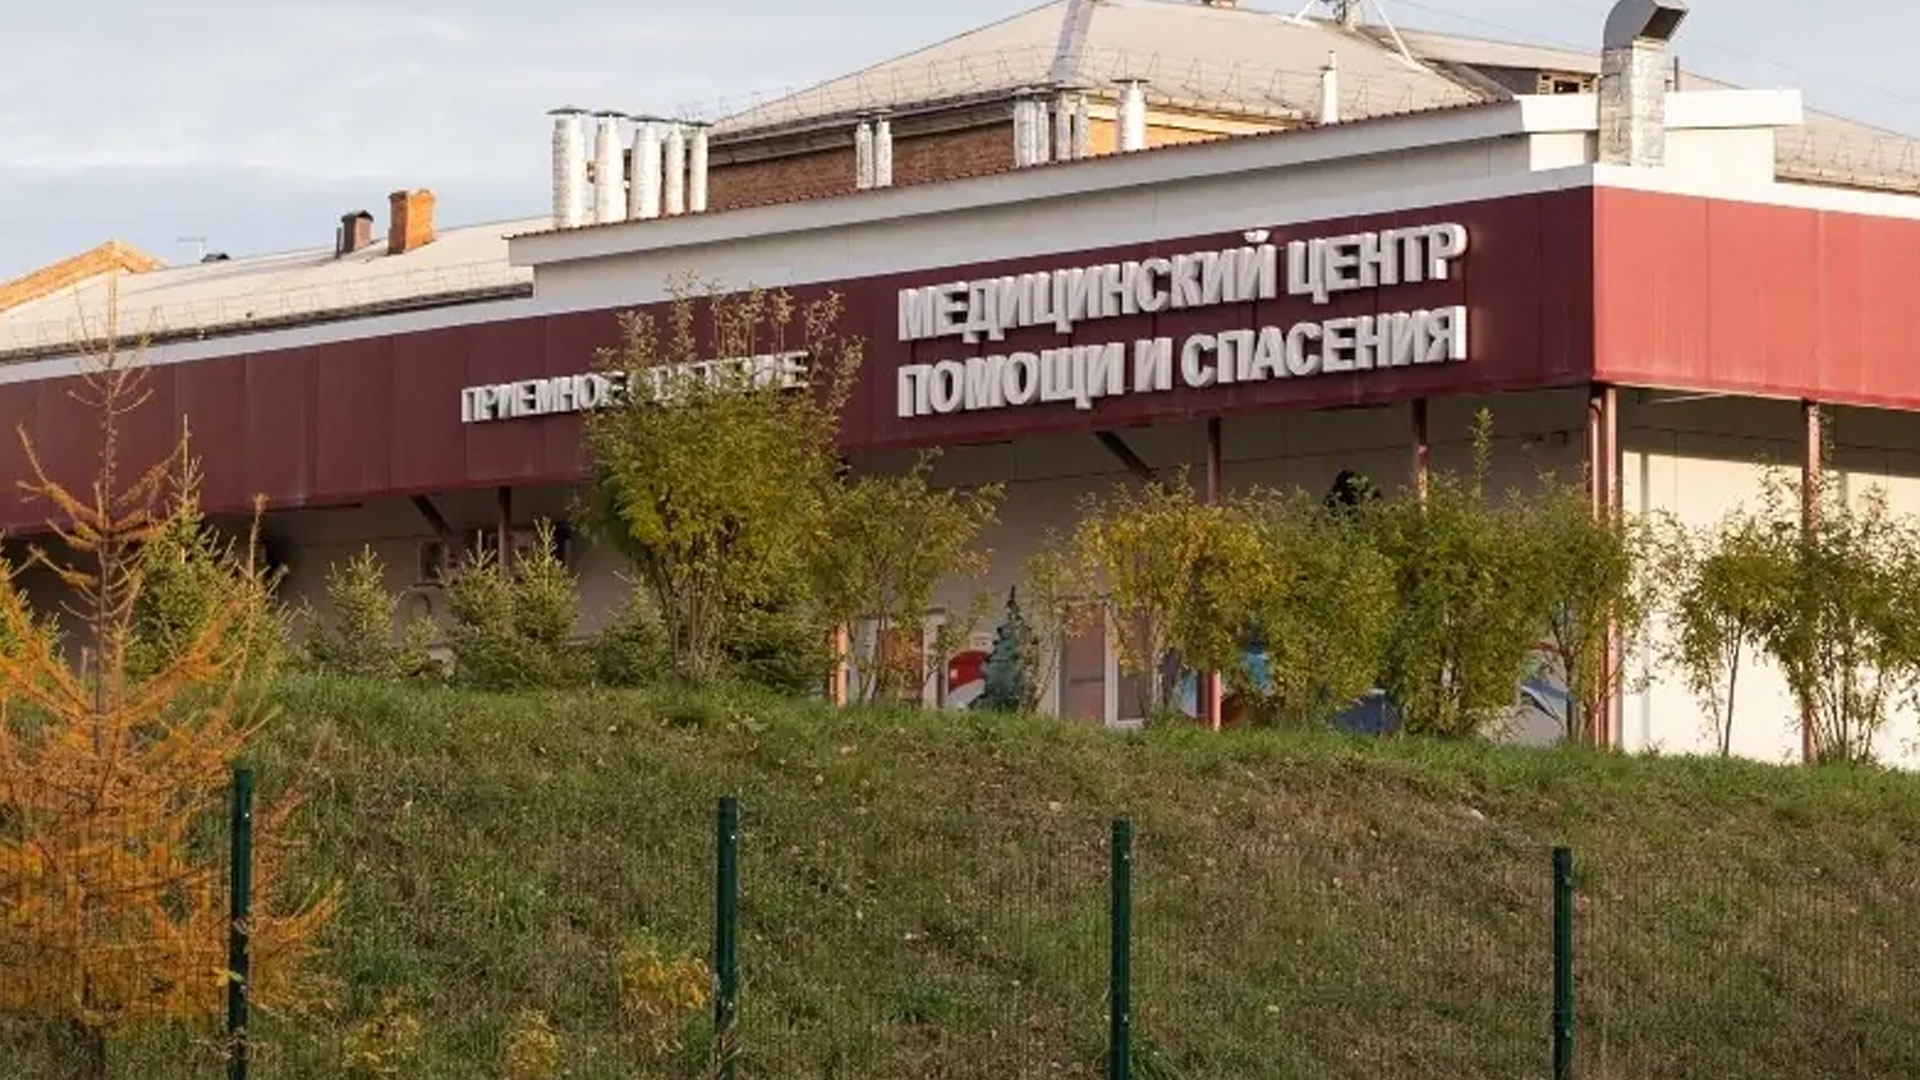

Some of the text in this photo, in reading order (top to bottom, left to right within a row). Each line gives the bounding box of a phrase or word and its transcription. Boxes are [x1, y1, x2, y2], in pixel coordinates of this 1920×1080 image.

[898, 222, 1468, 343] МЕДИЦИНСКИЙ ЦЕНТР
[461, 371, 626, 423] ПРИЕМНОЕ
[897, 305, 1467, 417] ПОМОЩИ И СПАСЕНИЯ
